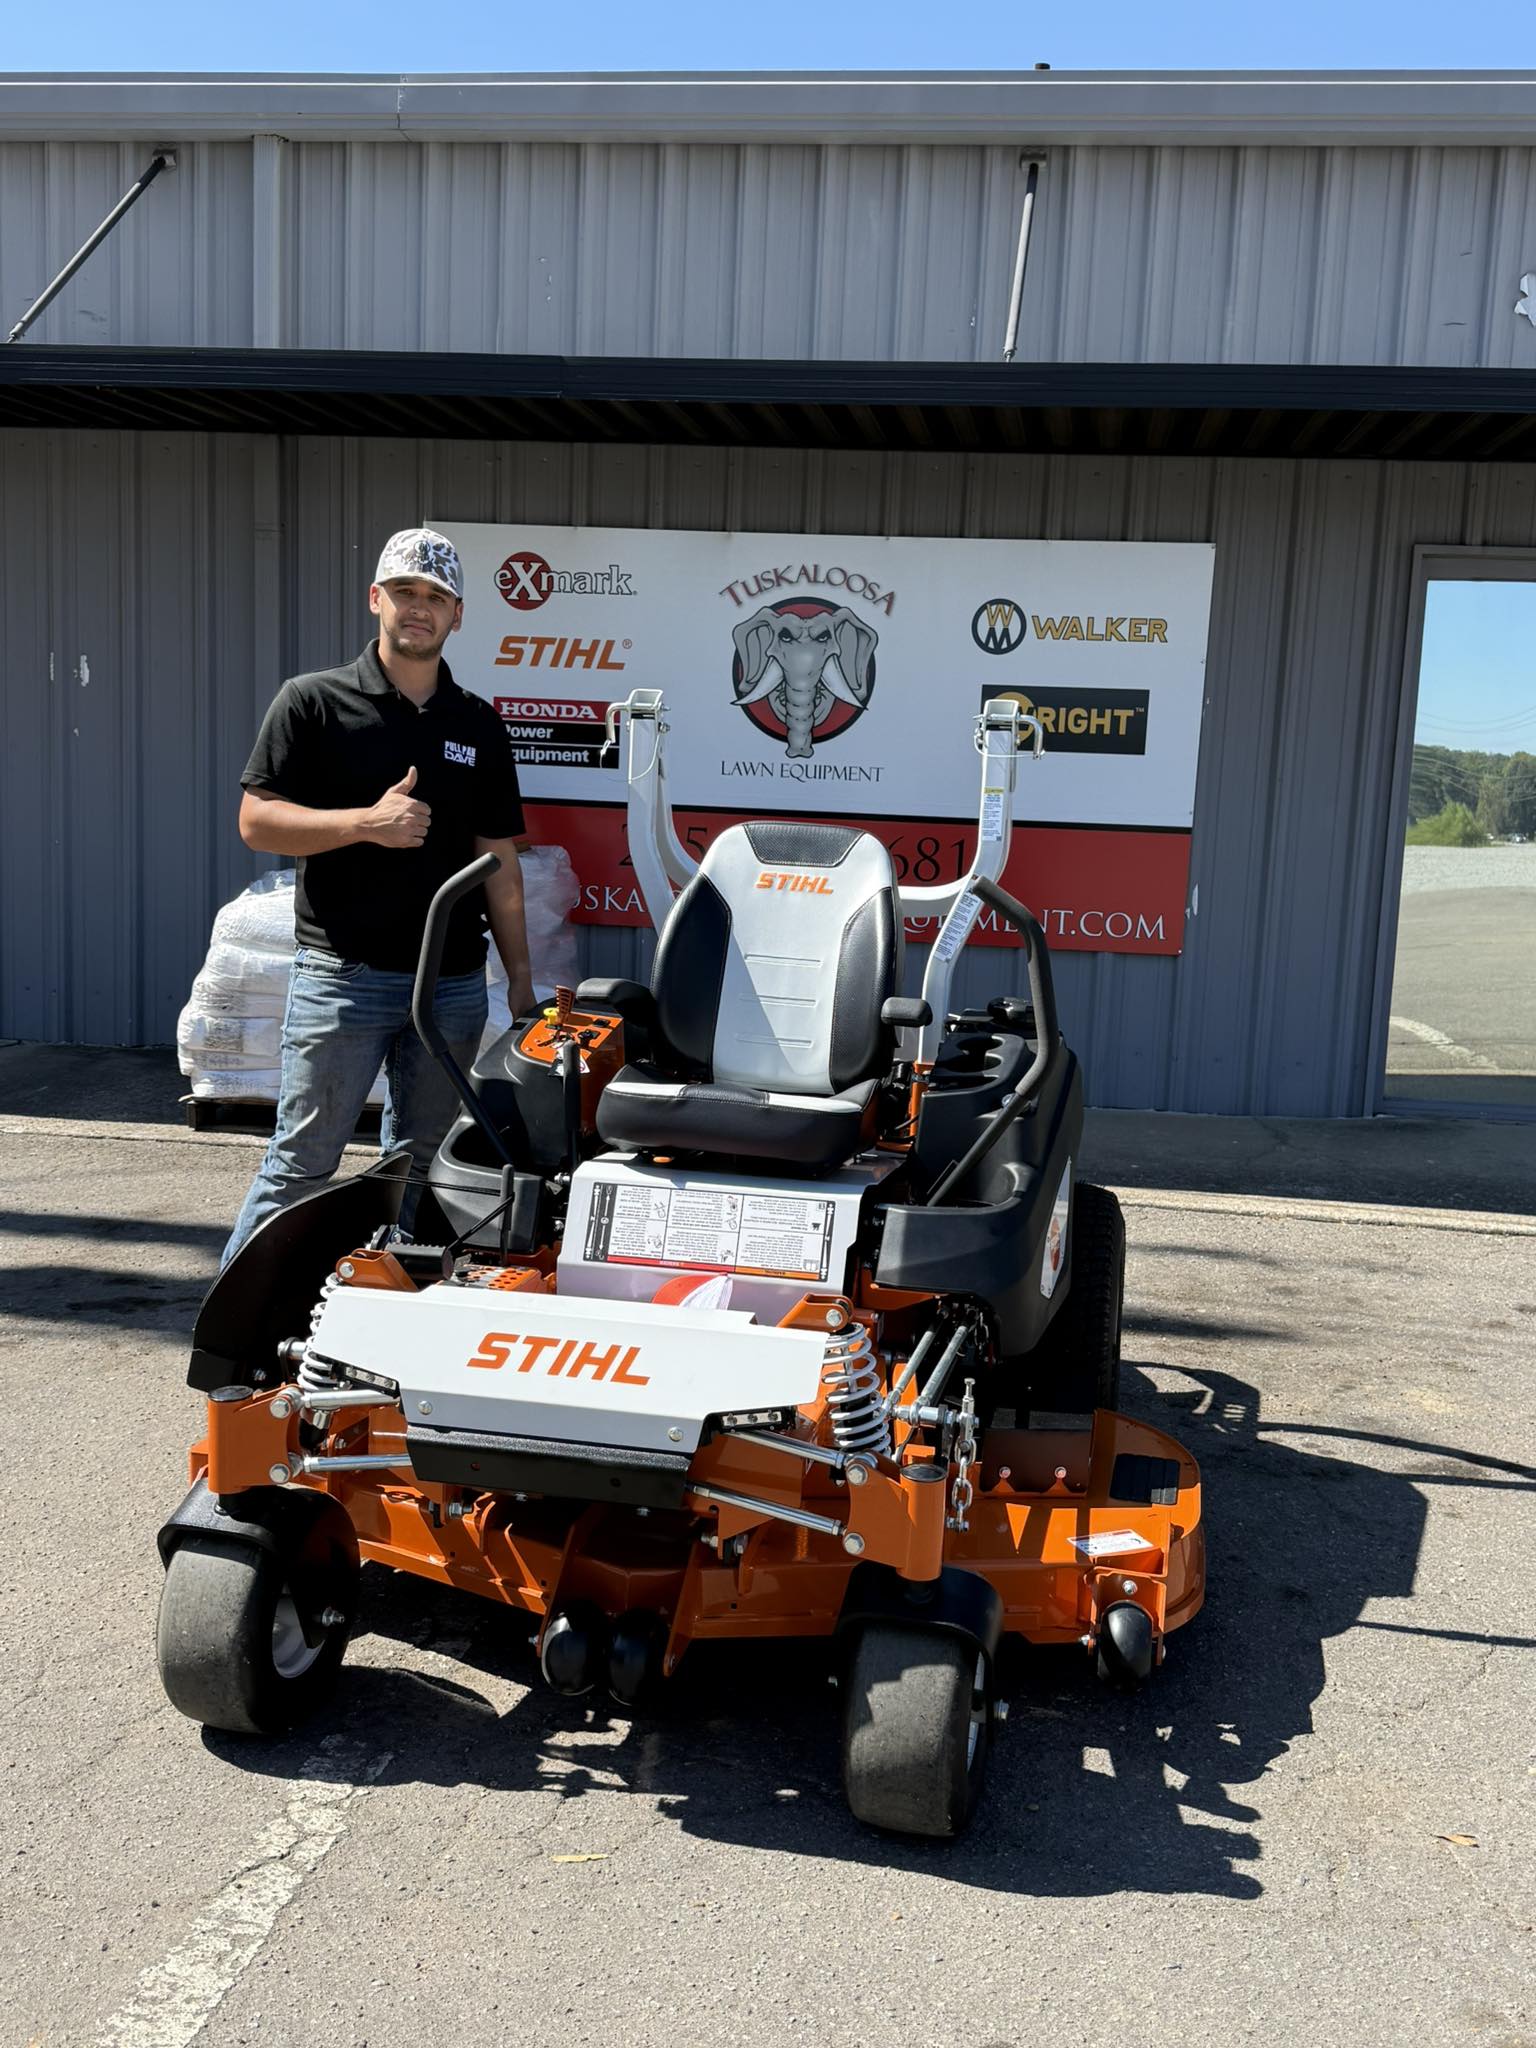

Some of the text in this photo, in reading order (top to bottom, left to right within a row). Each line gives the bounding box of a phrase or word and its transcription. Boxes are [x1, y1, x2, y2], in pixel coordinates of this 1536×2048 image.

[719, 564, 897, 616] TUSKALOOSA
[1031, 615, 1168, 643] WALKER
[500, 702, 597, 720] HONDA
[444, 750, 477, 767] DAVE
[511, 745, 590, 764] quipment
[721, 761, 885, 783] LAWN EQUIPMENT
[755, 872, 834, 895] STIHL
[466, 1331, 651, 1386] STIHL
